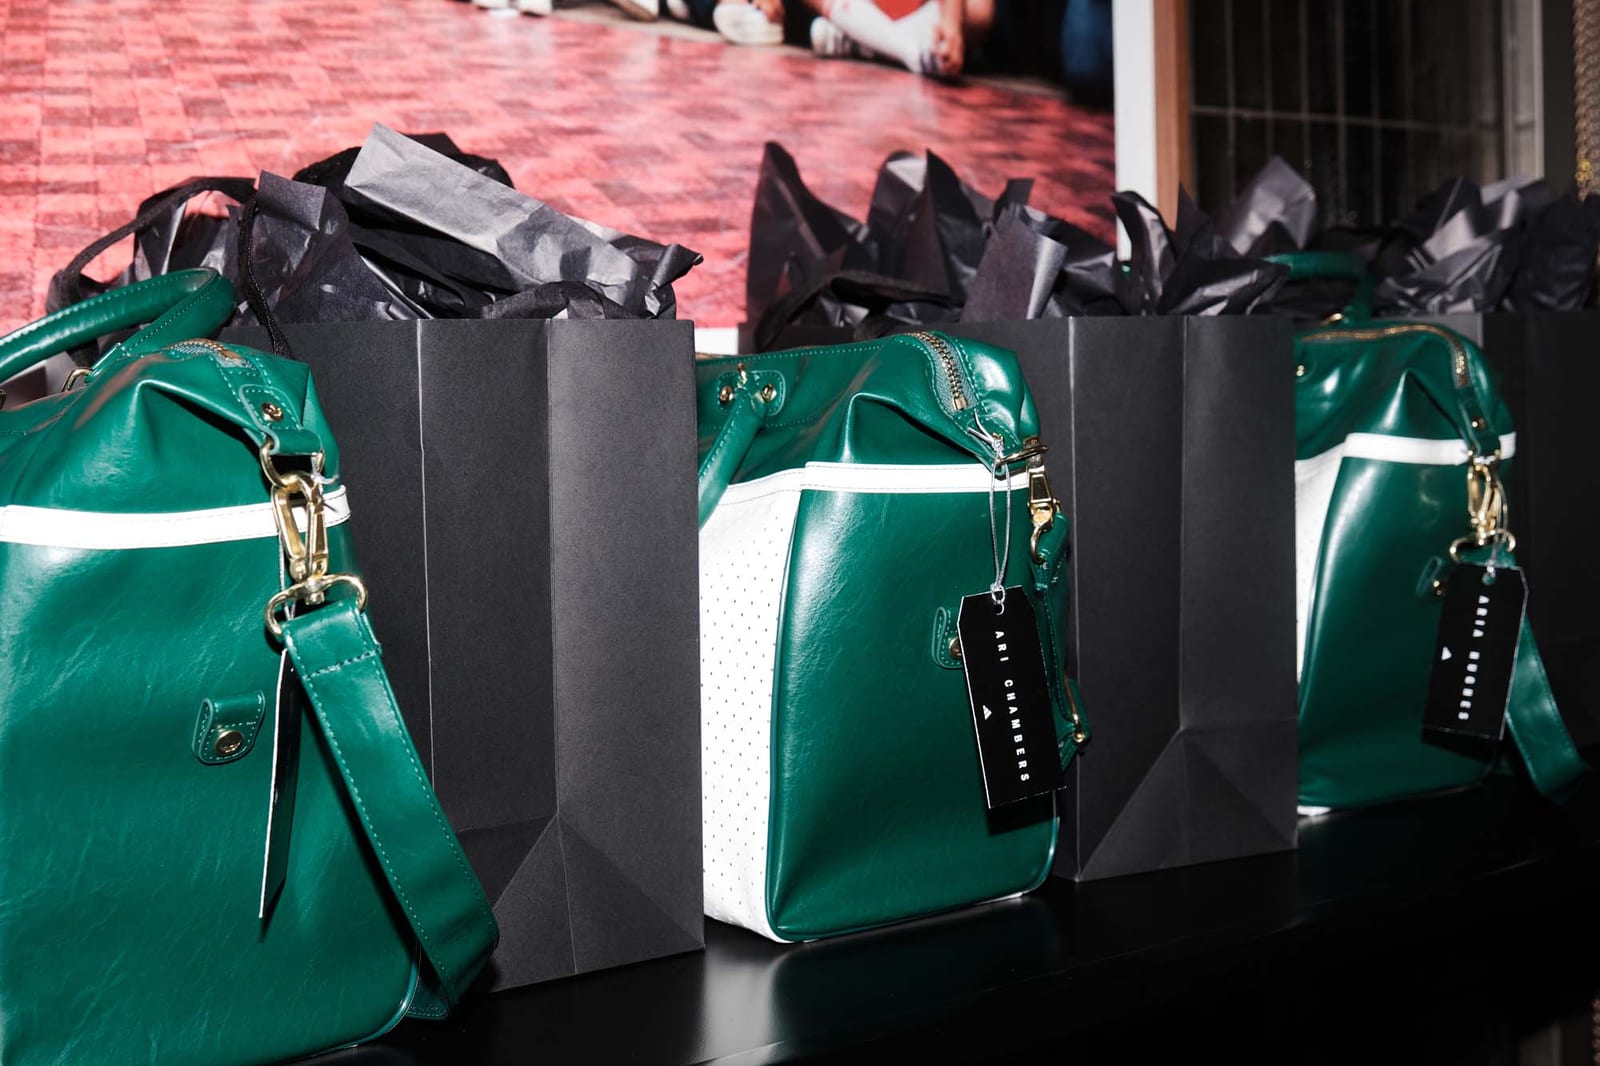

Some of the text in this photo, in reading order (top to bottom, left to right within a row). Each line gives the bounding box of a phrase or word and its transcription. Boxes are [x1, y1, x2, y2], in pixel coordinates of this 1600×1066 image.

[994, 630, 1030, 782] ARI CHAMBERS
[1457, 595, 1490, 720] ARIA HUGHES
